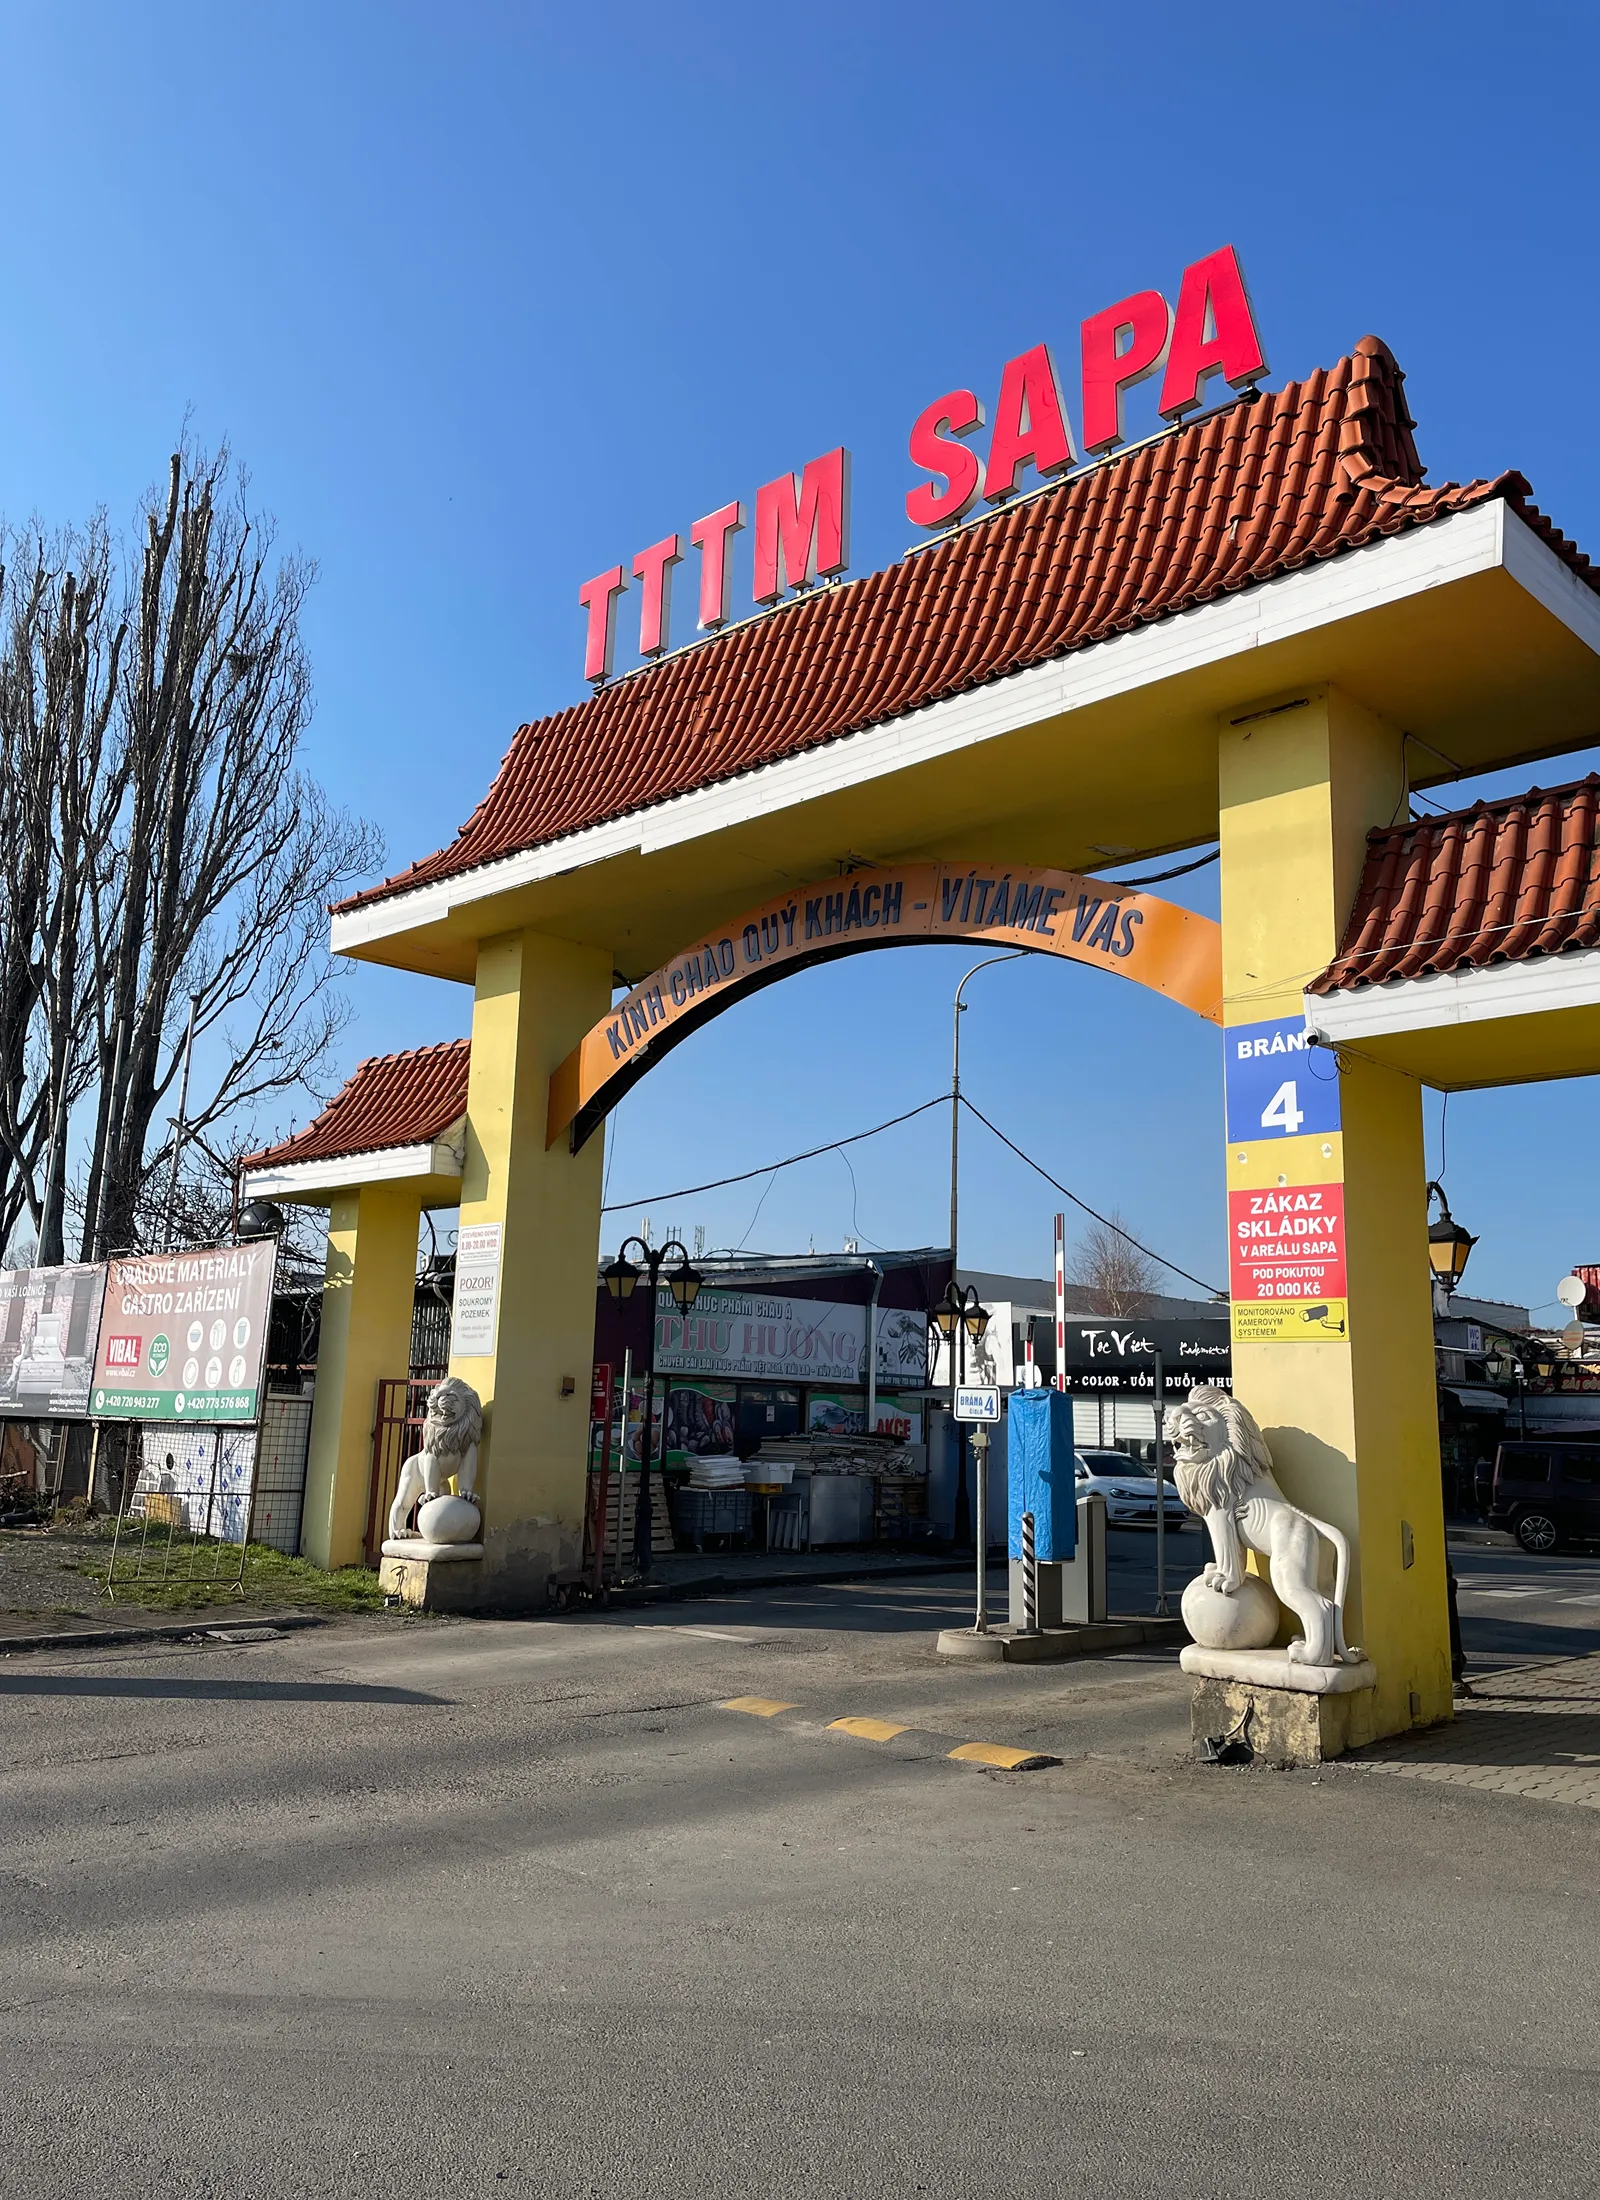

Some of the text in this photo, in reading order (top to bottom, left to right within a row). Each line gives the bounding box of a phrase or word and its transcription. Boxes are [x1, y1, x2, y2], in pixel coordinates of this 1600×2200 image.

[578, 244, 1270, 683] TTTM SAPA
[605, 985, 667, 1060] KÍNH
[668, 938, 736, 1008] CHÀO
[742, 900, 798, 963] QUÝ
[805, 881, 903, 940] KHÁCH
[941, 870, 1066, 936] VÍTÁME
[1071, 894, 1144, 957] VÁS
[1238, 1031, 1317, 1060] BRÁN
[1261, 1080, 1304, 1133] 4
[1250, 1192, 1322, 1214] ZÁKAZ
[1237, 1215, 1337, 1238] SKLÁDKY
[1240, 1241, 1337, 1257] V AREÁLU SAPA
[116, 1251, 257, 1285] OBALOVÉ MATERIÁLY
[1252, 1266, 1324, 1279] POD POKUTOU
[460, 1276, 494, 1289] POZOR!
[1257, 1282, 1321, 1296] 20 000 Kč
[121, 1282, 241, 1315] GASTRO ZAŘÍZENÍ
[459, 1296, 493, 1306] SOUKROMÝ
[461, 1309, 490, 1319] POZEMEK
[756, 1300, 782, 1318] CHÂU
[1237, 1306, 1295, 1316] MONITOROVÁNO
[1238, 1316, 1283, 1326] KAMEROVÝM
[655, 1315, 857, 1363] THU HƯỜNG
[1238, 1327, 1277, 1337] SYSTÉMEM
[1469, 1329, 1479, 1340] WC
[109, 1338, 138, 1363] VIBAL
[153, 1342, 167, 1353] ECO
[1050, 1375, 1072, 1386] CT
[1082, 1375, 1120, 1387] COLOR
[1130, 1371, 1154, 1387] UỐN
[105, 1396, 160, 1409] +420 720 943 277
[187, 1397, 204, 1409] +420
[220, 1397, 234, 1409] 576
[235, 1396, 249, 1409] 868
[960, 1394, 994, 1415] BRÁNA 4
[877, 1418, 911, 1440] AKCE
